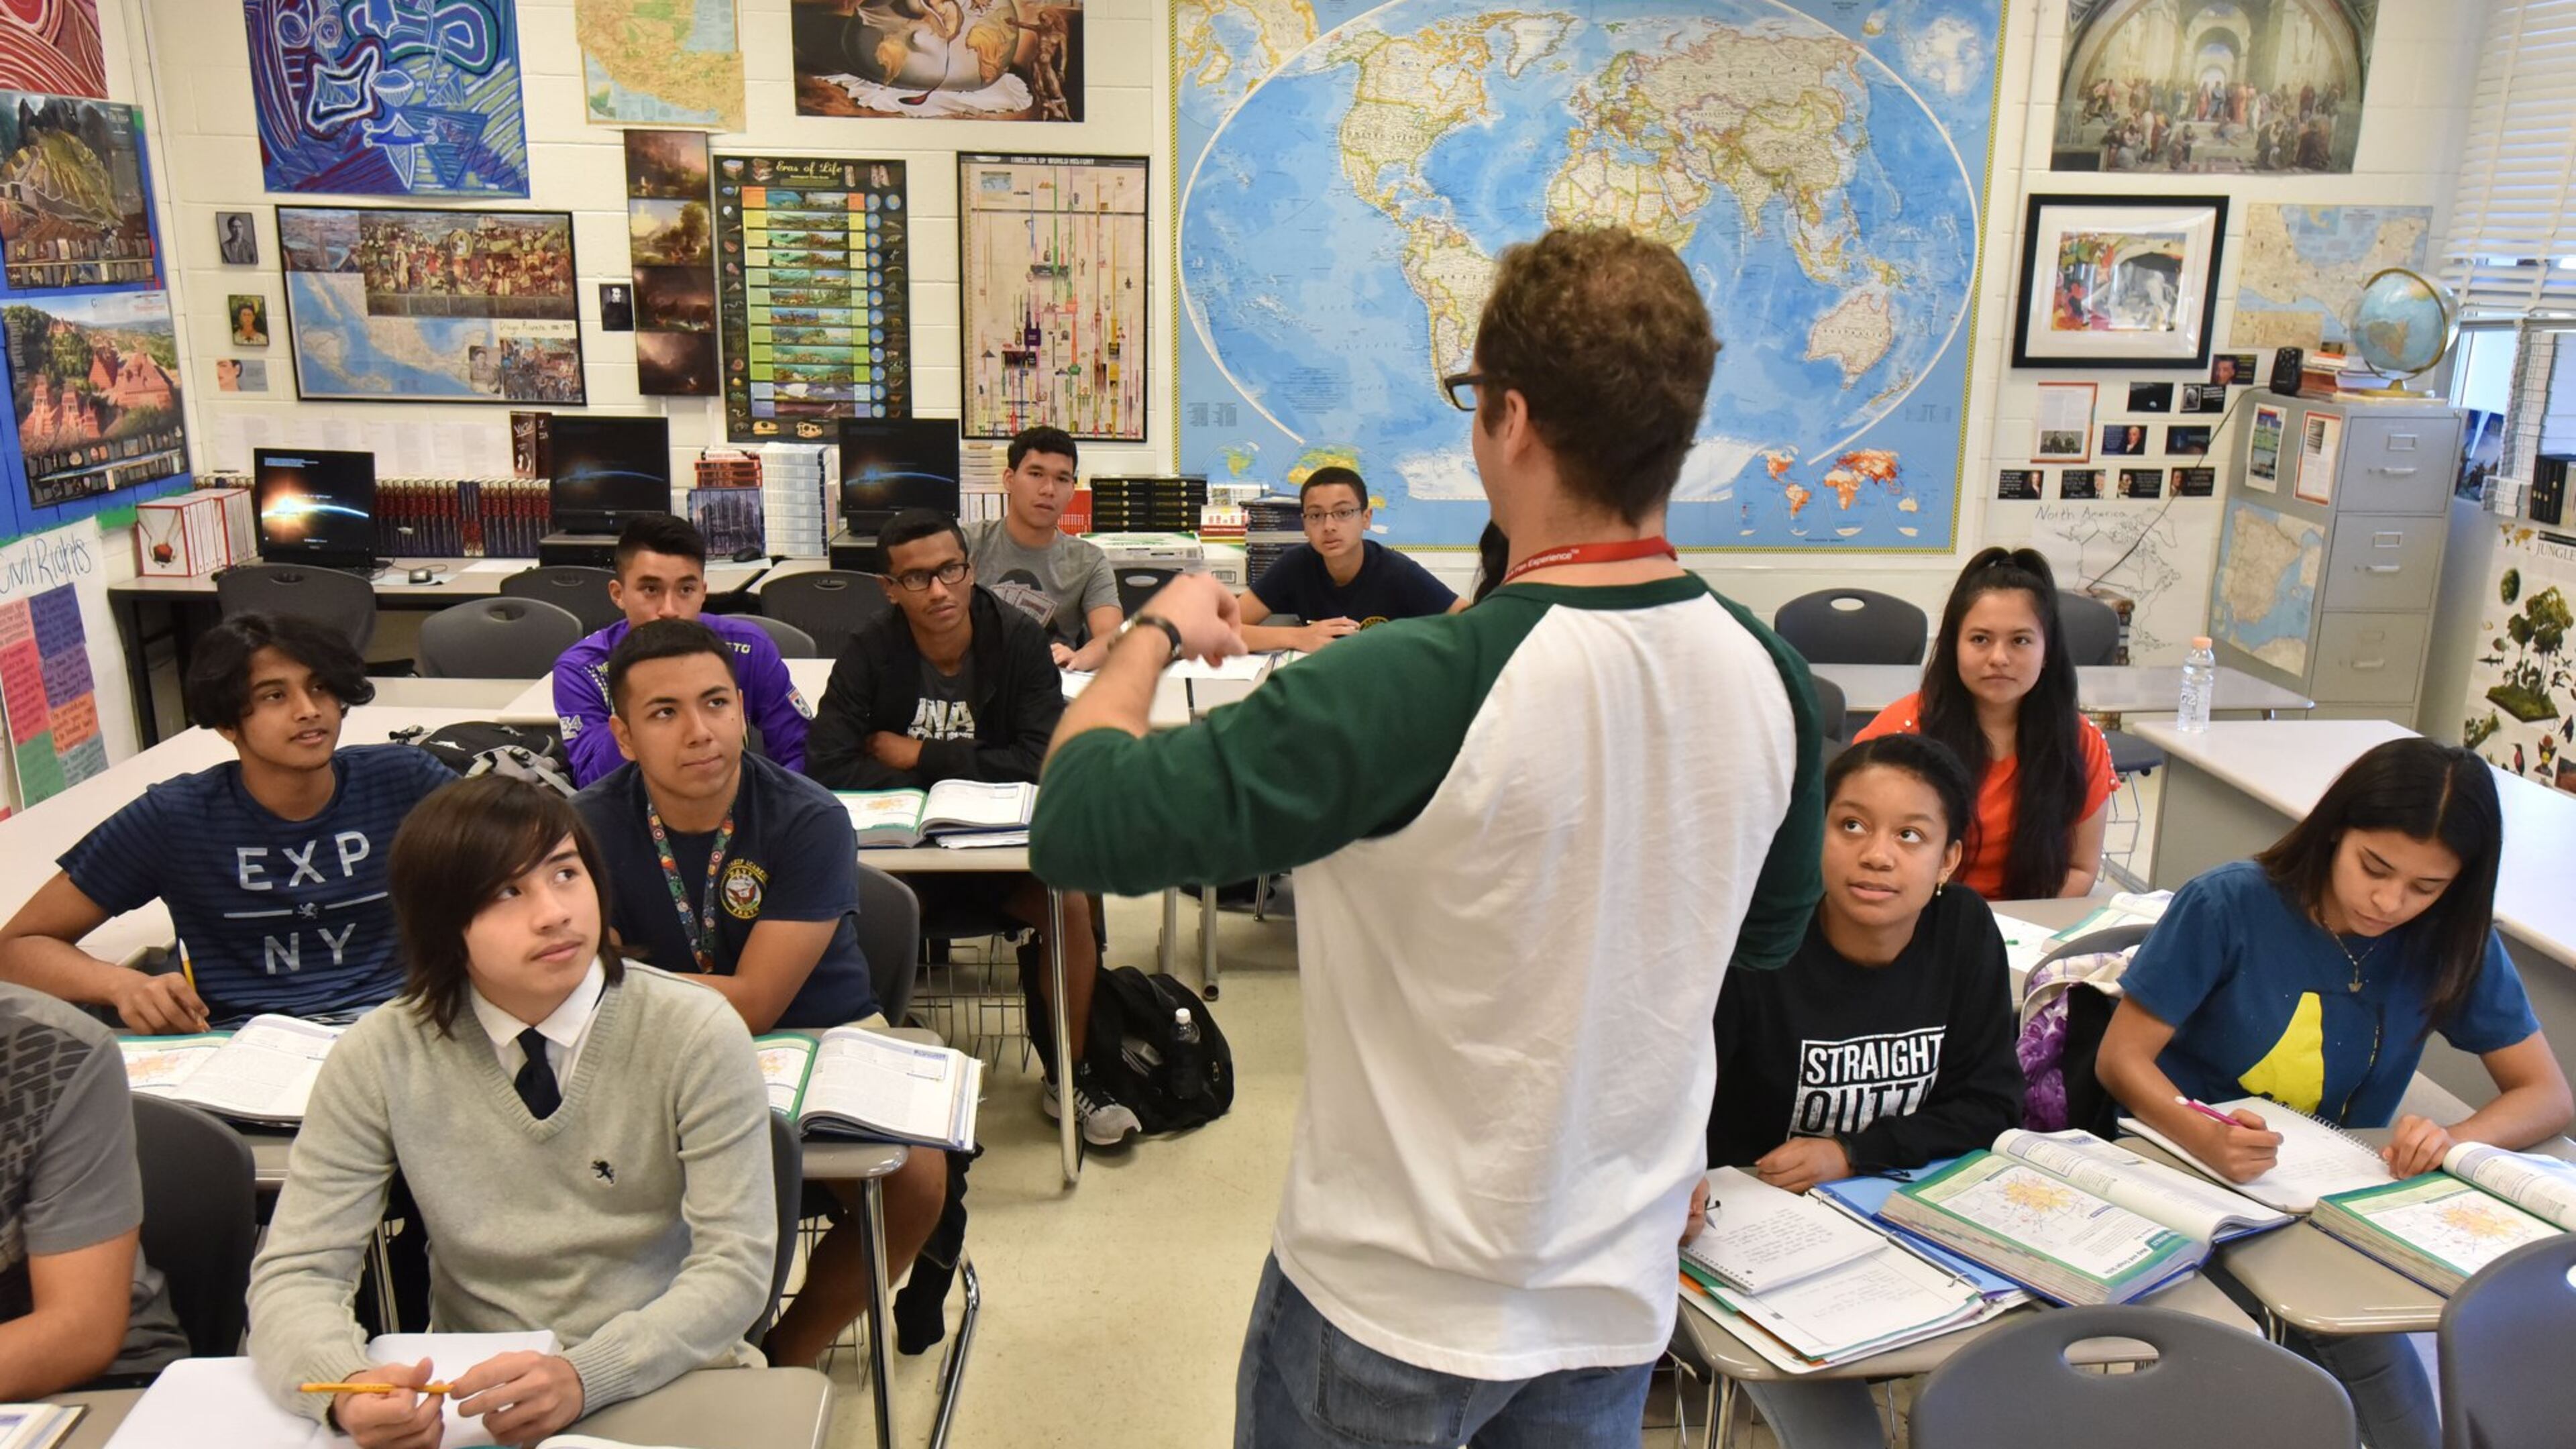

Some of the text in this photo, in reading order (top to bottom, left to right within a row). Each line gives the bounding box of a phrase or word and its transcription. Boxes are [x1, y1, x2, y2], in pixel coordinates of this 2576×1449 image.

[776, 161, 842, 176] Eras of Life
[2035, 504, 2074, 521] North
[237, 831, 370, 891] EXP
[264, 923, 356, 975] NY
[1805, 1032, 1945, 1085] STRAIGHT
